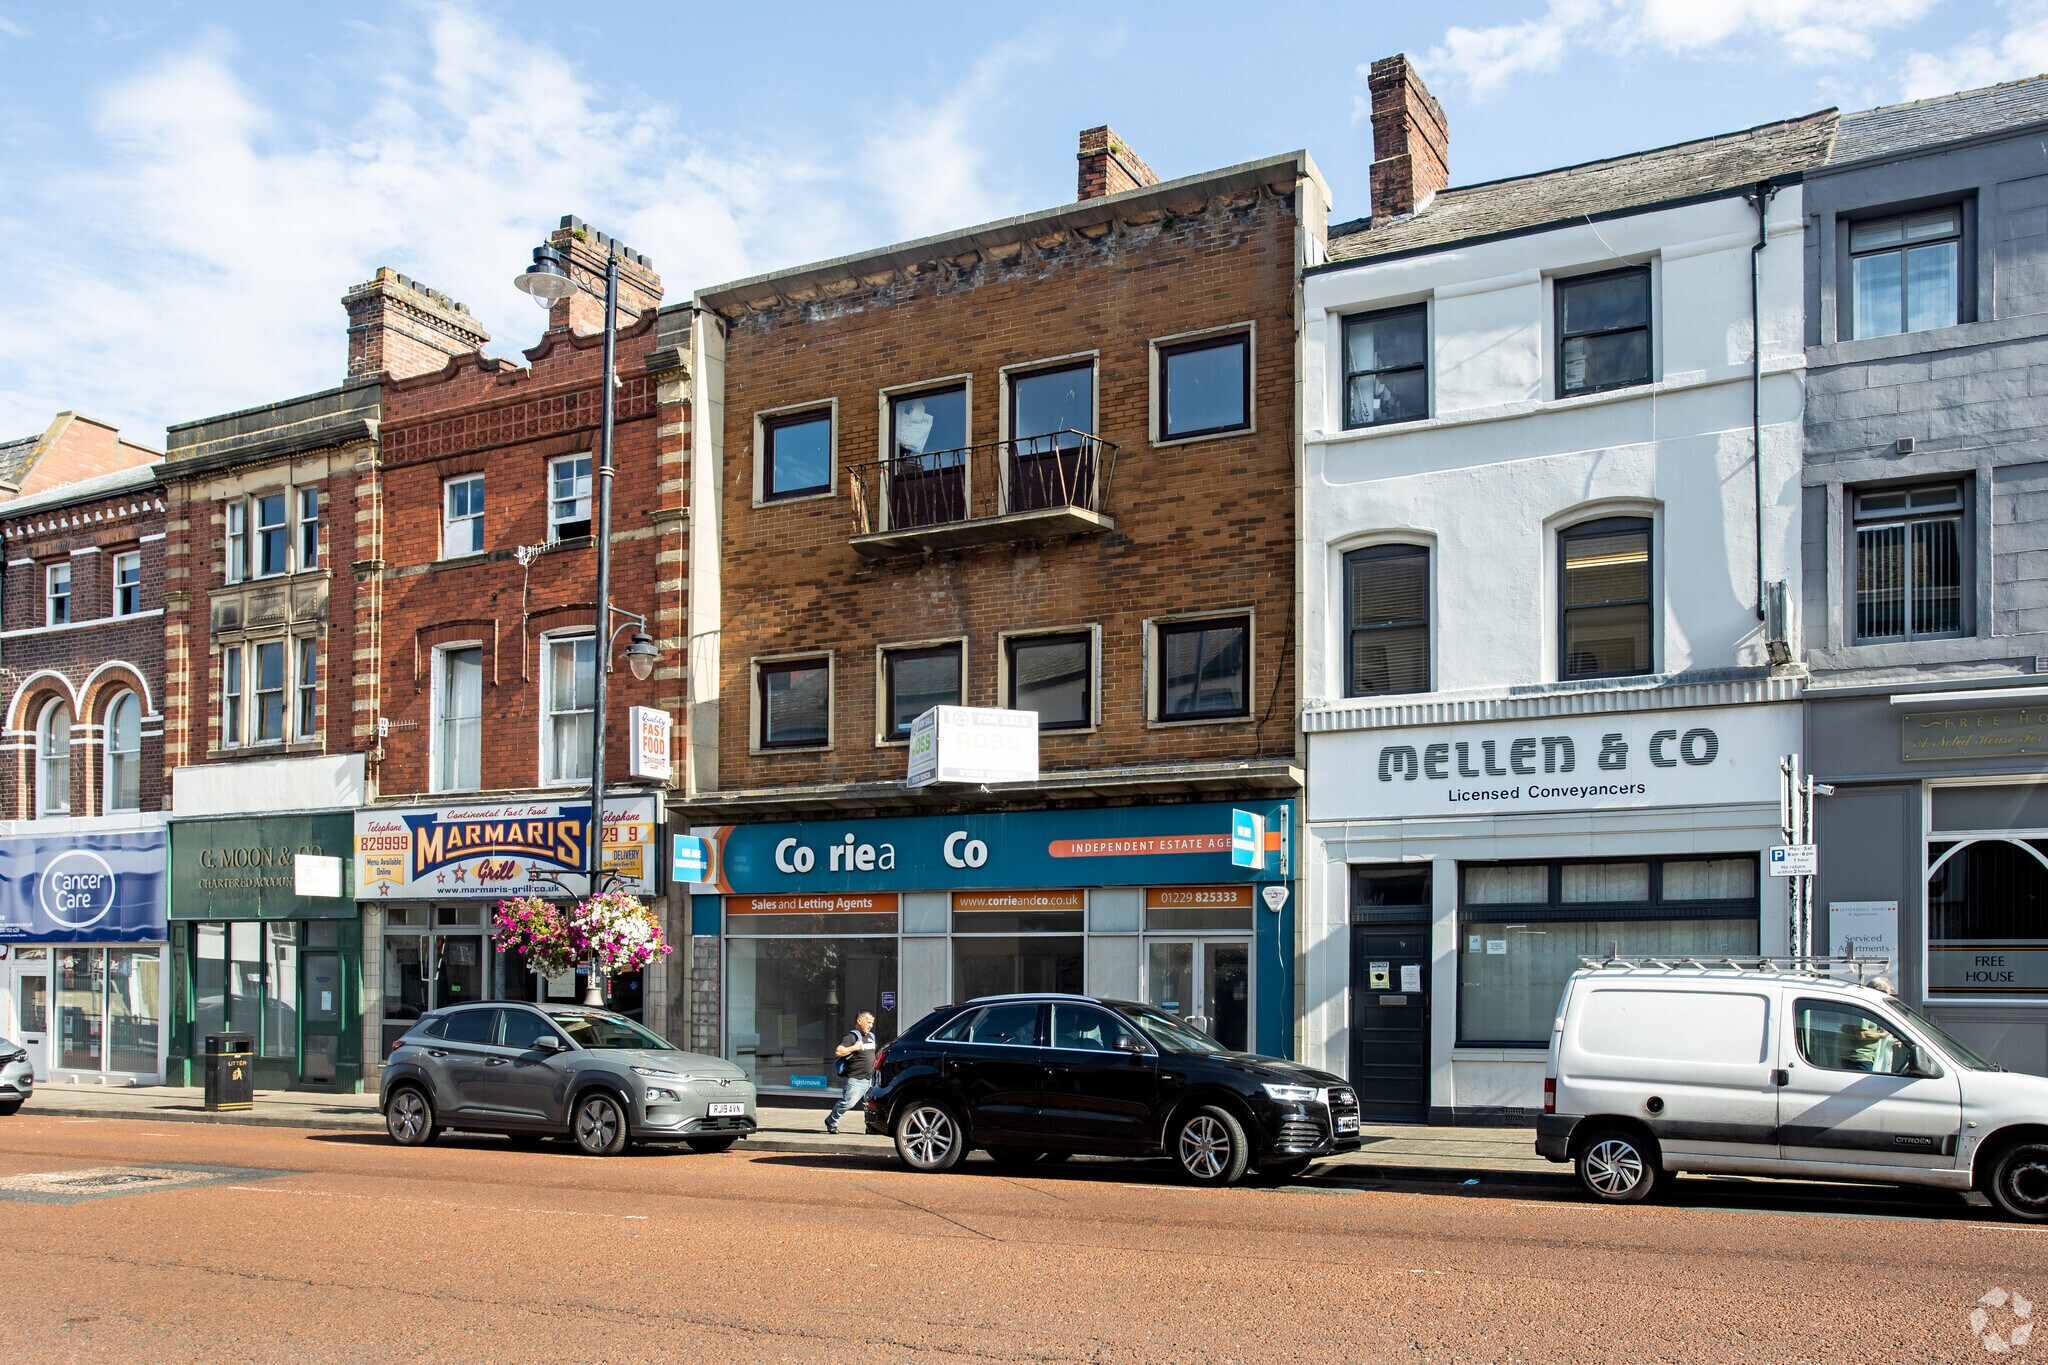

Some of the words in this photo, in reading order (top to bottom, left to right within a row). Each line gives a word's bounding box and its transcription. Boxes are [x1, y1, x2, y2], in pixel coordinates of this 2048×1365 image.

[642, 712, 665, 727] Quality
[977, 714, 999, 725] FOR
[1002, 716, 1029, 726] SALE
[1944, 716, 2000, 728] FREE
[643, 723, 665, 737] FAST
[643, 736, 665, 755] FOOD
[911, 733, 931, 757] ROSS
[956, 730, 1021, 752] ROSS
[1932, 734, 1973, 747] Noted
[1974, 733, 2015, 745] House
[1378, 735, 1576, 782] MELLEN
[1598, 732, 1629, 770] &
[1649, 727, 1720, 768] CO
[1448, 785, 1521, 803] Licensed
[1528, 782, 1646, 801] Conveyancers
[446, 808, 501, 821] Continental
[502, 807, 525, 818] Fast
[527, 806, 548, 817] Food
[602, 810, 640, 825] Telephone
[367, 821, 402, 836] Telephone
[361, 835, 408, 851] 829999
[416, 818, 582, 874] MARMARIS
[1071, 839, 1155, 853] INDEPENDENT
[1159, 838, 1203, 850] ESTATE
[1208, 837, 1232, 849] AGE
[220, 846, 275, 868] MOON
[278, 846, 293, 866] &
[613, 849, 640, 861] DELIVERY
[775, 837, 815, 874] Co
[943, 830, 988, 868] Co
[1774, 850, 1784, 861] P
[367, 858, 379, 866] Menu
[381, 857, 402, 866] Available
[377, 867, 391, 875] Online
[476, 858, 515, 886] Grill
[52, 871, 105, 890] Cancer
[199, 877, 254, 889] CHARTERED
[436, 884, 560, 896] www.marmaris-grillco.uk
[1161, 892, 1193, 903] 01229
[1195, 891, 1238, 903] 825333
[55, 889, 91, 912] Care
[751, 899, 777, 910] Sales
[778, 899, 796, 910] and
[798, 898, 834, 911] Letting
[836, 897, 872, 911] Agents
[959, 894, 1078, 907] www.corrieandco.co.uk
[1844, 934, 1882, 943] Serviced
[1837, 945, 1890, 954] Artments
[1975, 955, 2005, 967] FREE
[1965, 971, 2015, 982] HOUSE
[791, 1078, 821, 1087] rightmove
[729, 1104, 741, 1113] AVN
